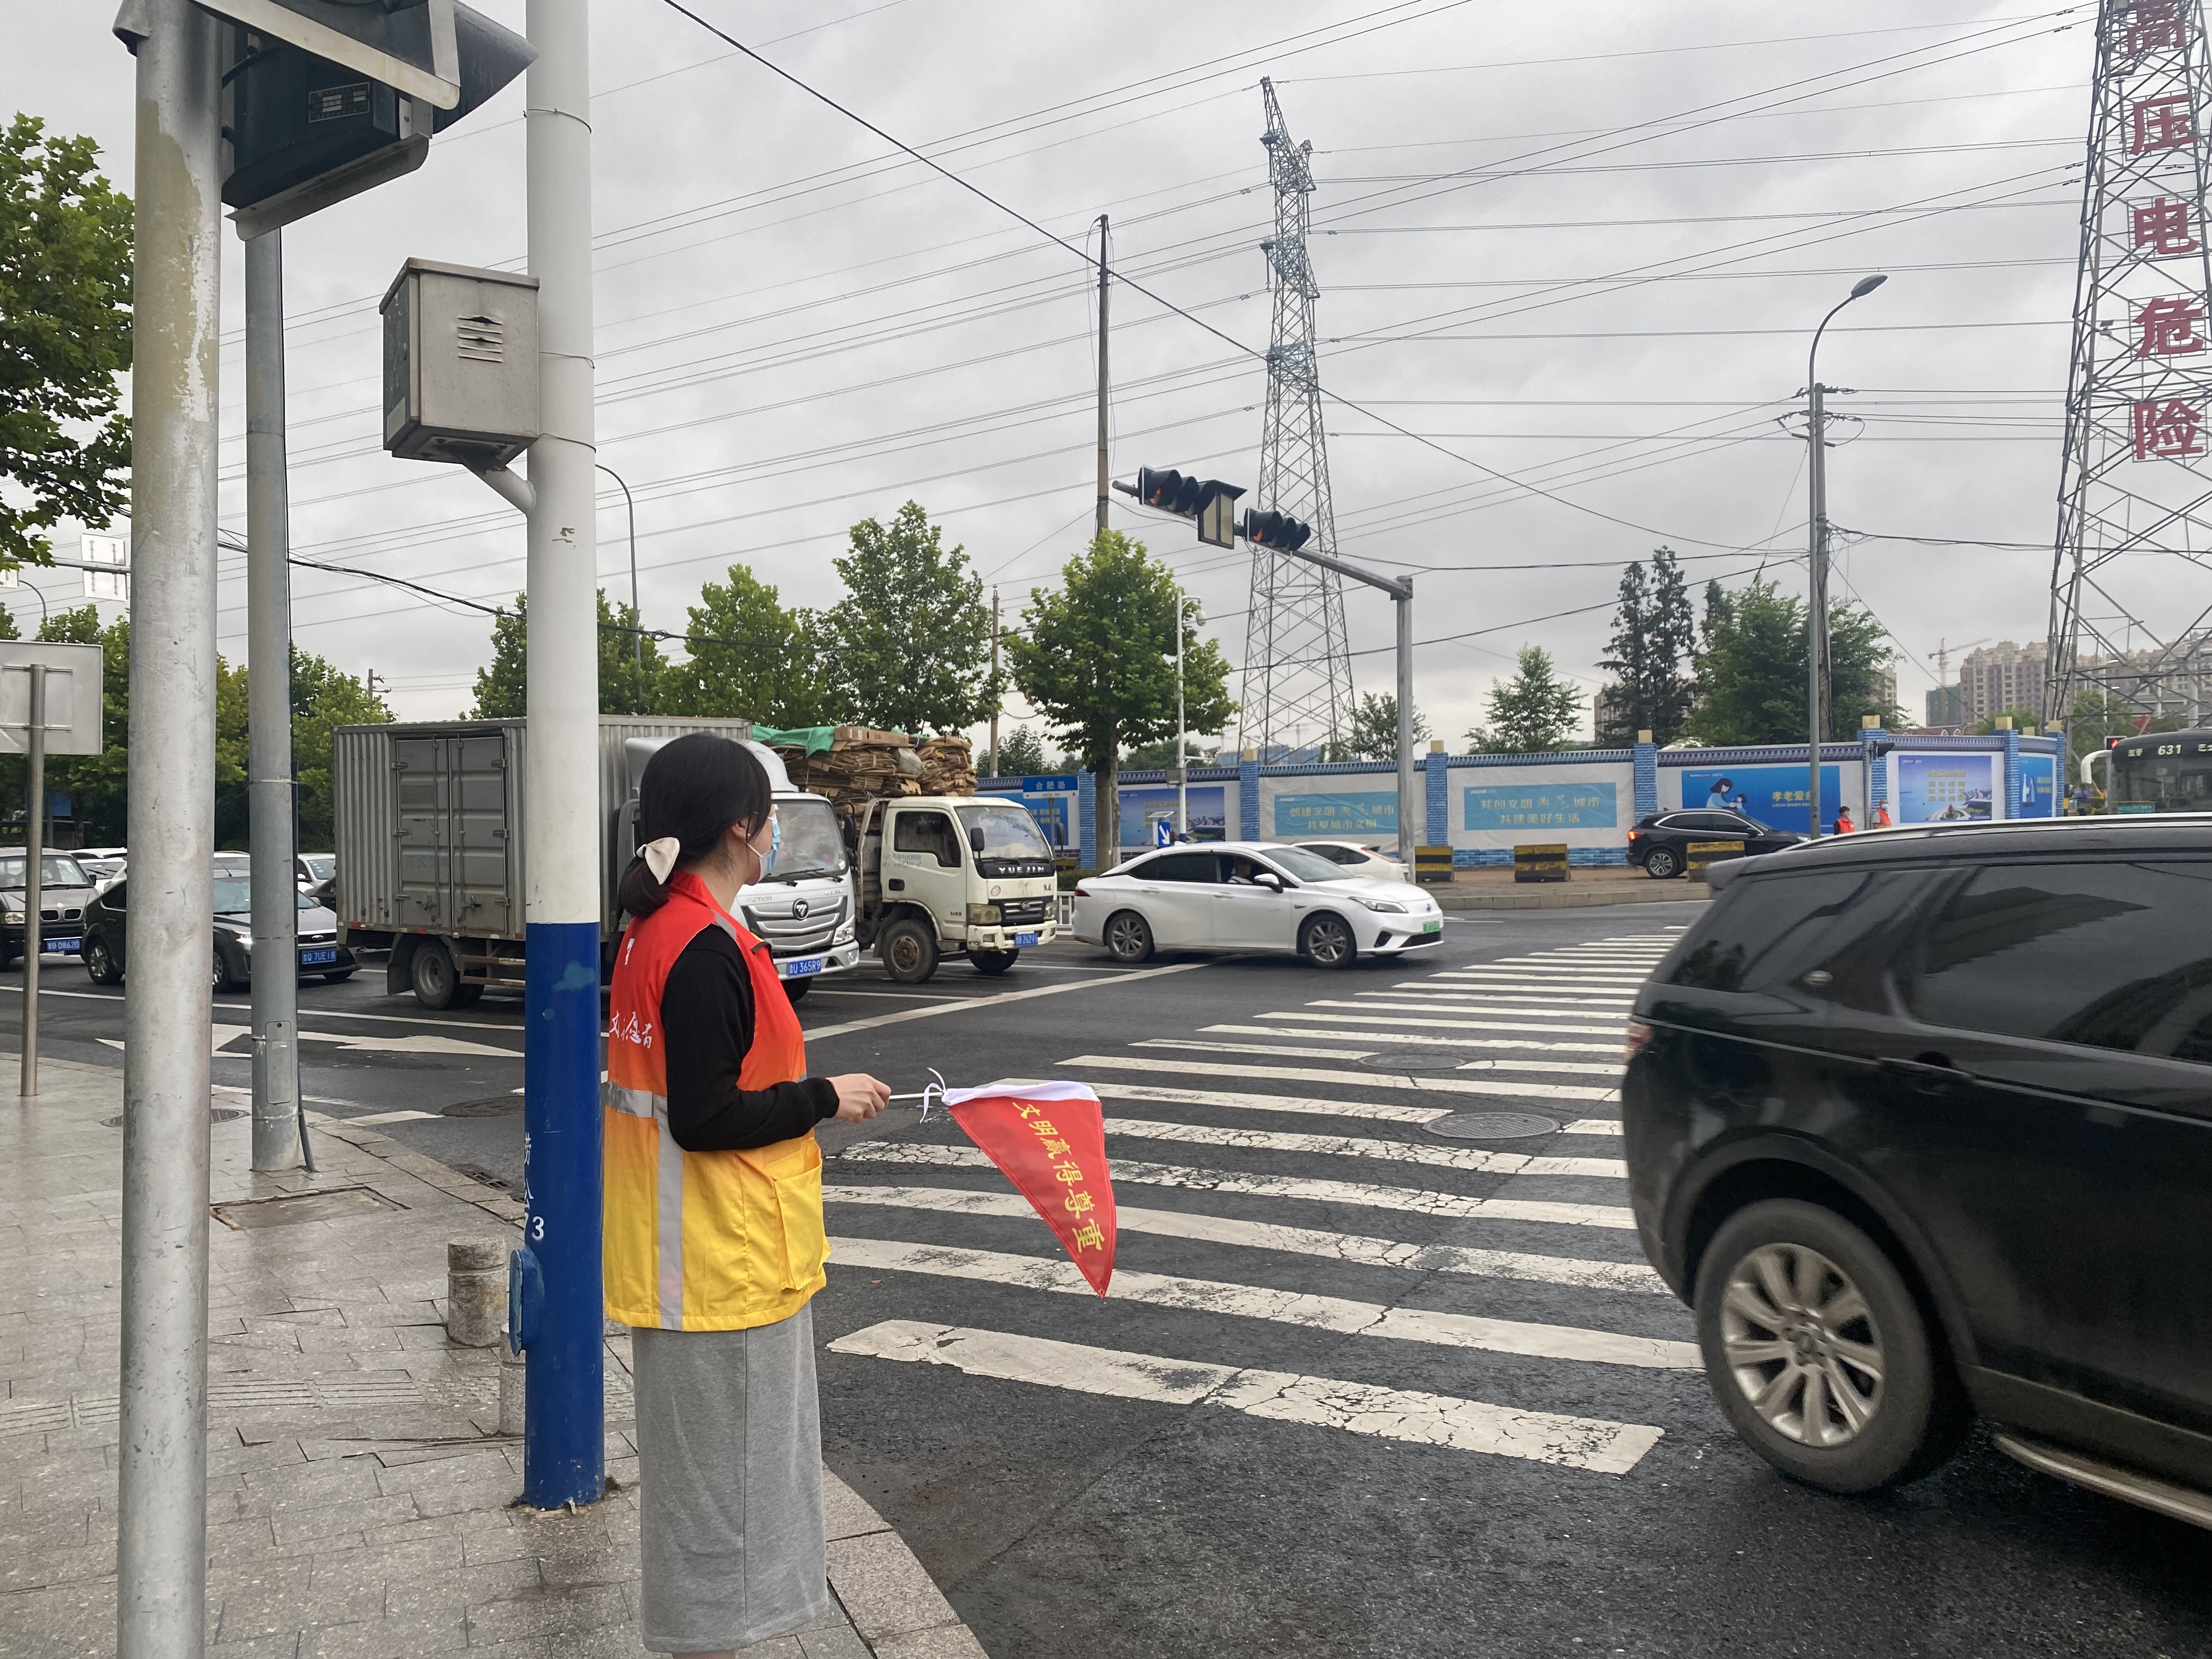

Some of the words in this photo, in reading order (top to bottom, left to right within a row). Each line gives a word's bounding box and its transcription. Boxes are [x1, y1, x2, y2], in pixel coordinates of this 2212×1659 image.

[2126, 0, 2204, 460] 高压电危险
[2158, 744, 2182, 755] 631
[1036, 781, 1065, 791] 合肥路
[1500, 812, 1581, 825] 共建美好生活
[1308, 819, 1377, 831] 共享城市文明
[1012, 1102, 1105, 1253] 文明赢得尊重
